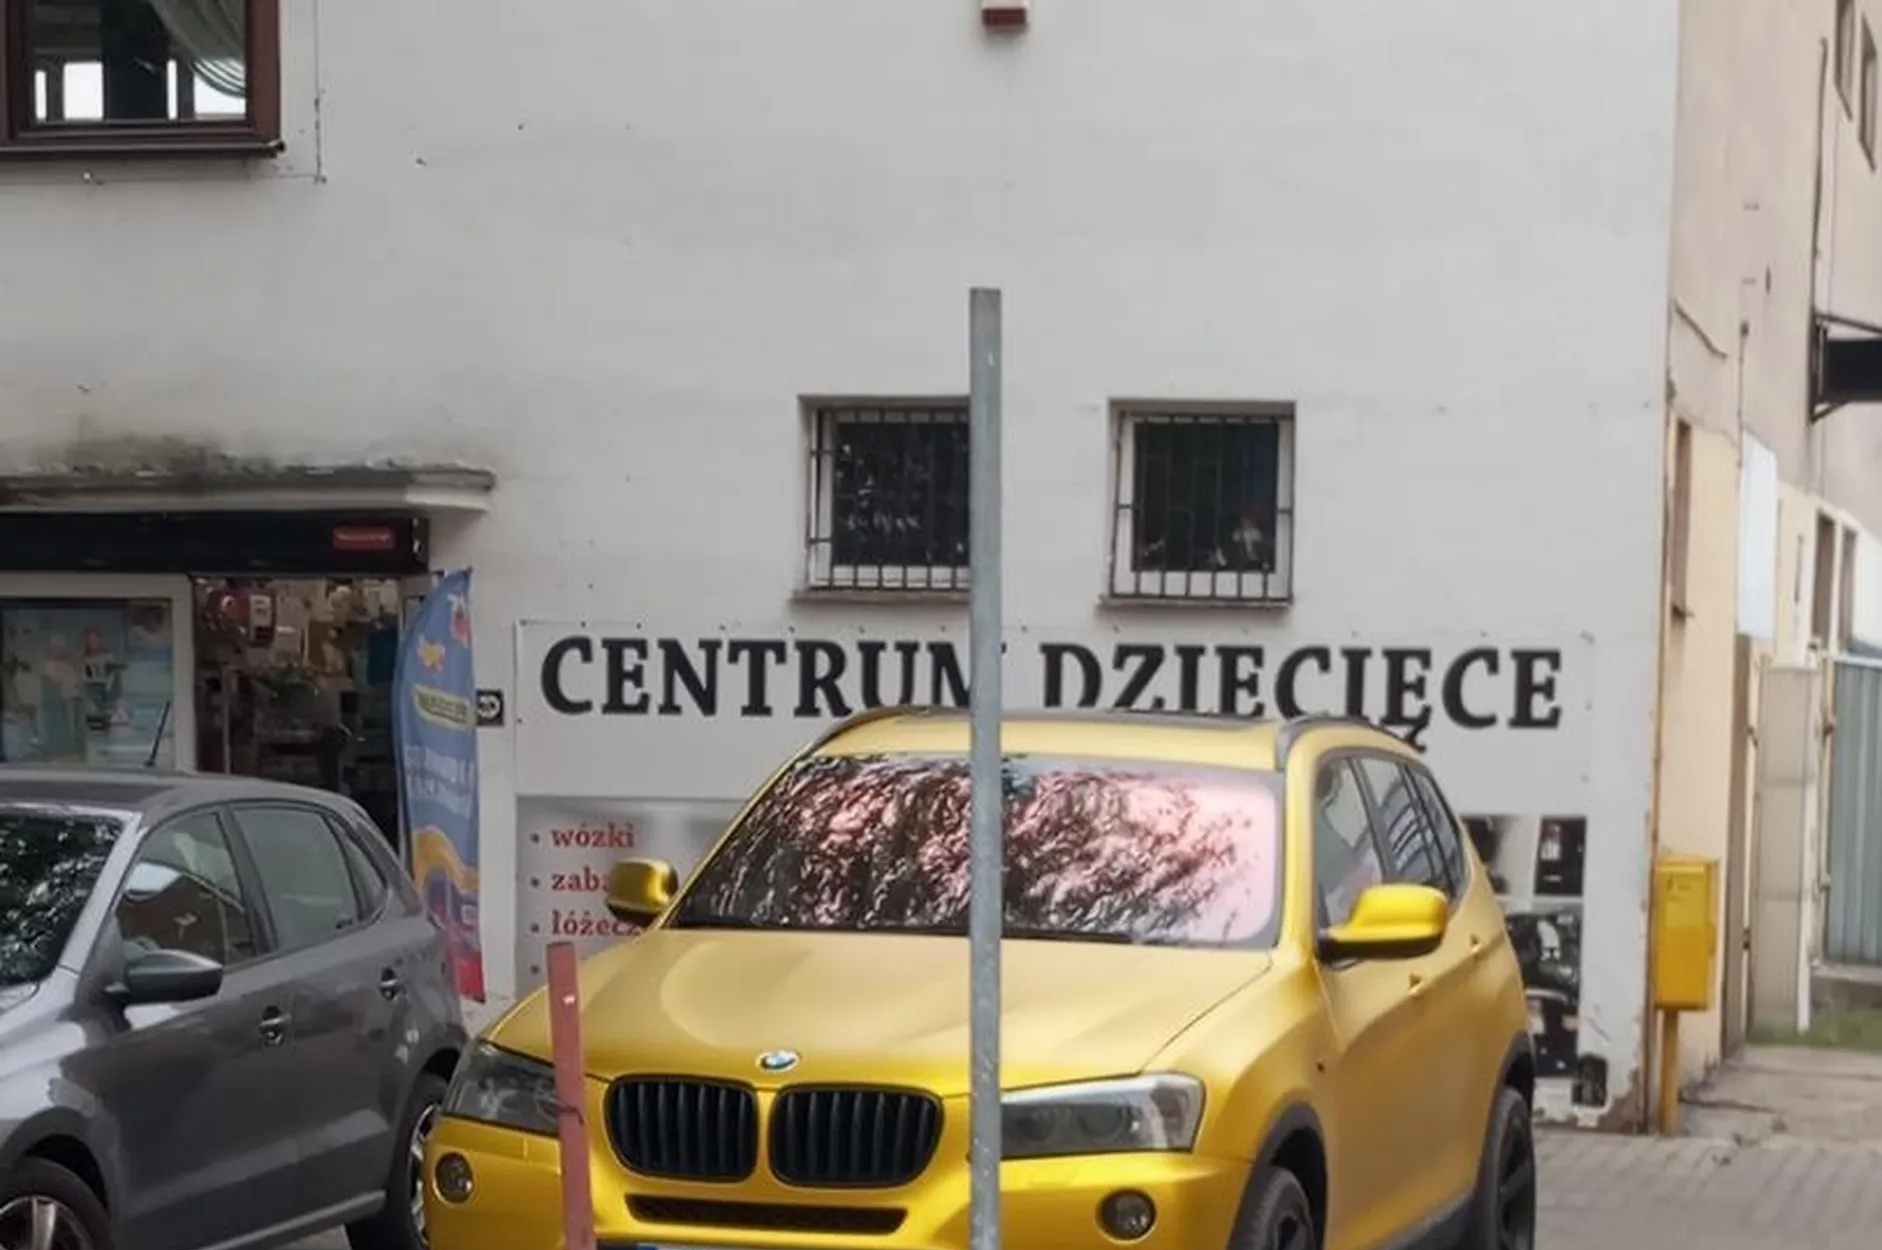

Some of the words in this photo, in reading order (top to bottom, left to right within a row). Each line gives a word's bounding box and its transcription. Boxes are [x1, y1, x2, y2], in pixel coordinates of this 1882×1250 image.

[1038, 642, 1562, 753] DZIECIĘCE
[552, 822, 634, 848] wózki
[551, 866, 609, 892] zab
